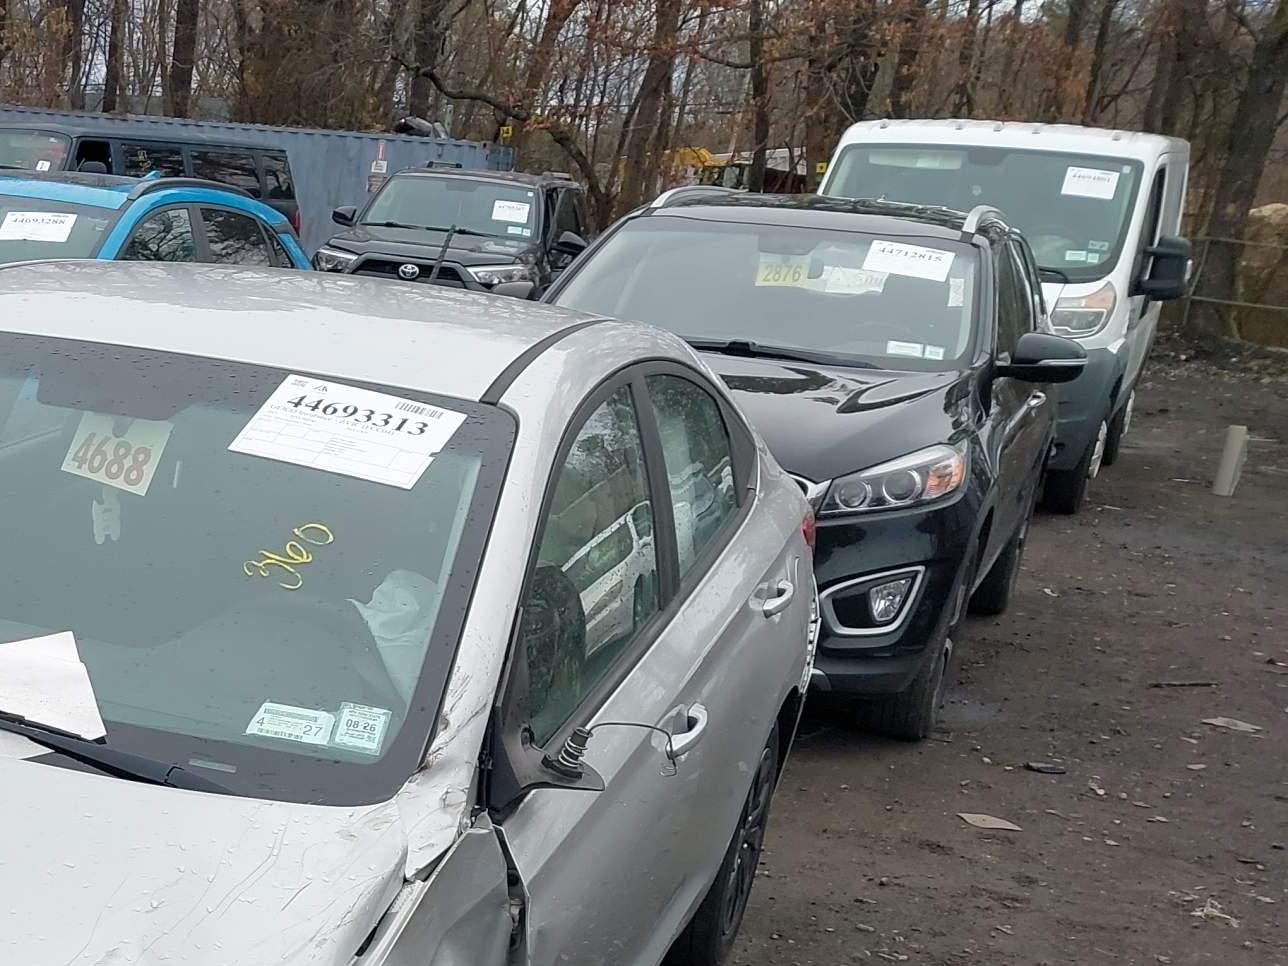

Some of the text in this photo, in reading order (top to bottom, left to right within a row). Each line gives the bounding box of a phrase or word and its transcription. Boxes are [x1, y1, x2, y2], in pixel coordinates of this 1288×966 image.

[879, 246, 943, 263] 44712815
[762, 263, 803, 283] 2876
[287, 394, 430, 436] 44693313
[72, 432, 152, 486] 4688
[243, 523, 334, 590] 360
[256, 716, 265, 727] 4
[302, 724, 323, 737] 27
